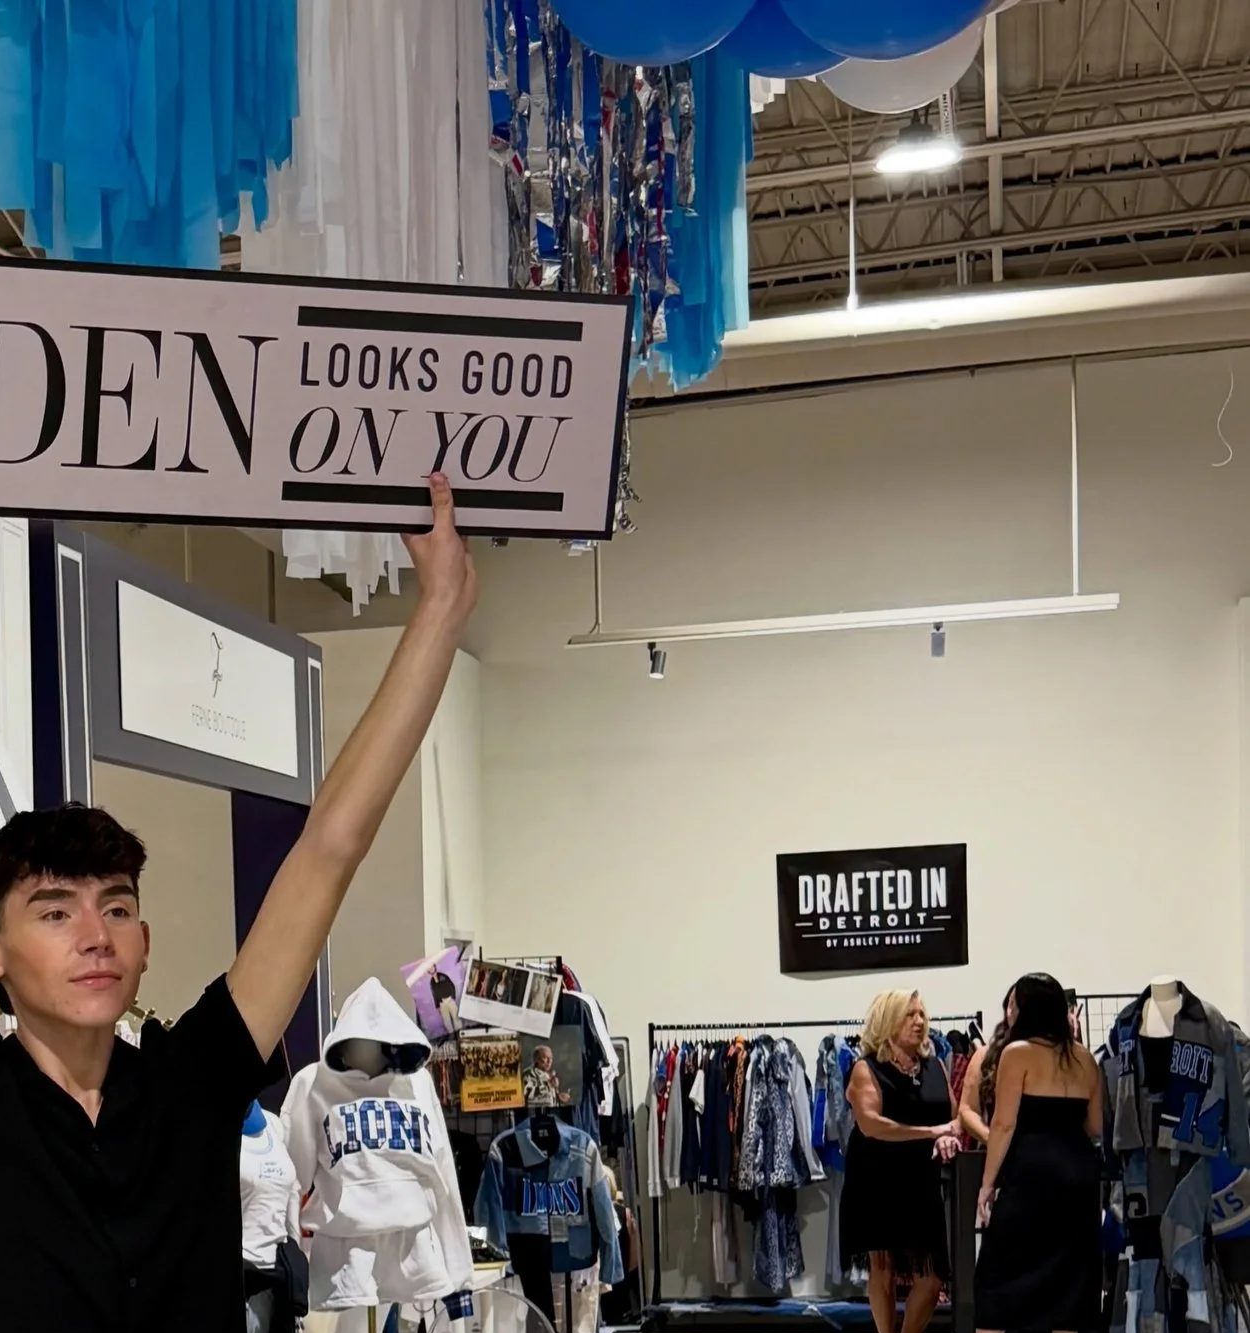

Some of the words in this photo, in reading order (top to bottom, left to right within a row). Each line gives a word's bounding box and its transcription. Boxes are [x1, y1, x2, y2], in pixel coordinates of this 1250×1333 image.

[300, 341, 439, 393] LOOKS
[461, 351, 573, 399] GOOD
[289, 406, 407, 476] ON
[426, 411, 573, 482] YOU
[798, 870, 912, 915] DRAFTED
[920, 867, 947, 909] IN
[819, 913, 927, 930] DETROIT
[826, 938, 838, 948] BY
[843, 935, 880, 947] ASHLEY
[885, 934, 922, 945] HARRIS
